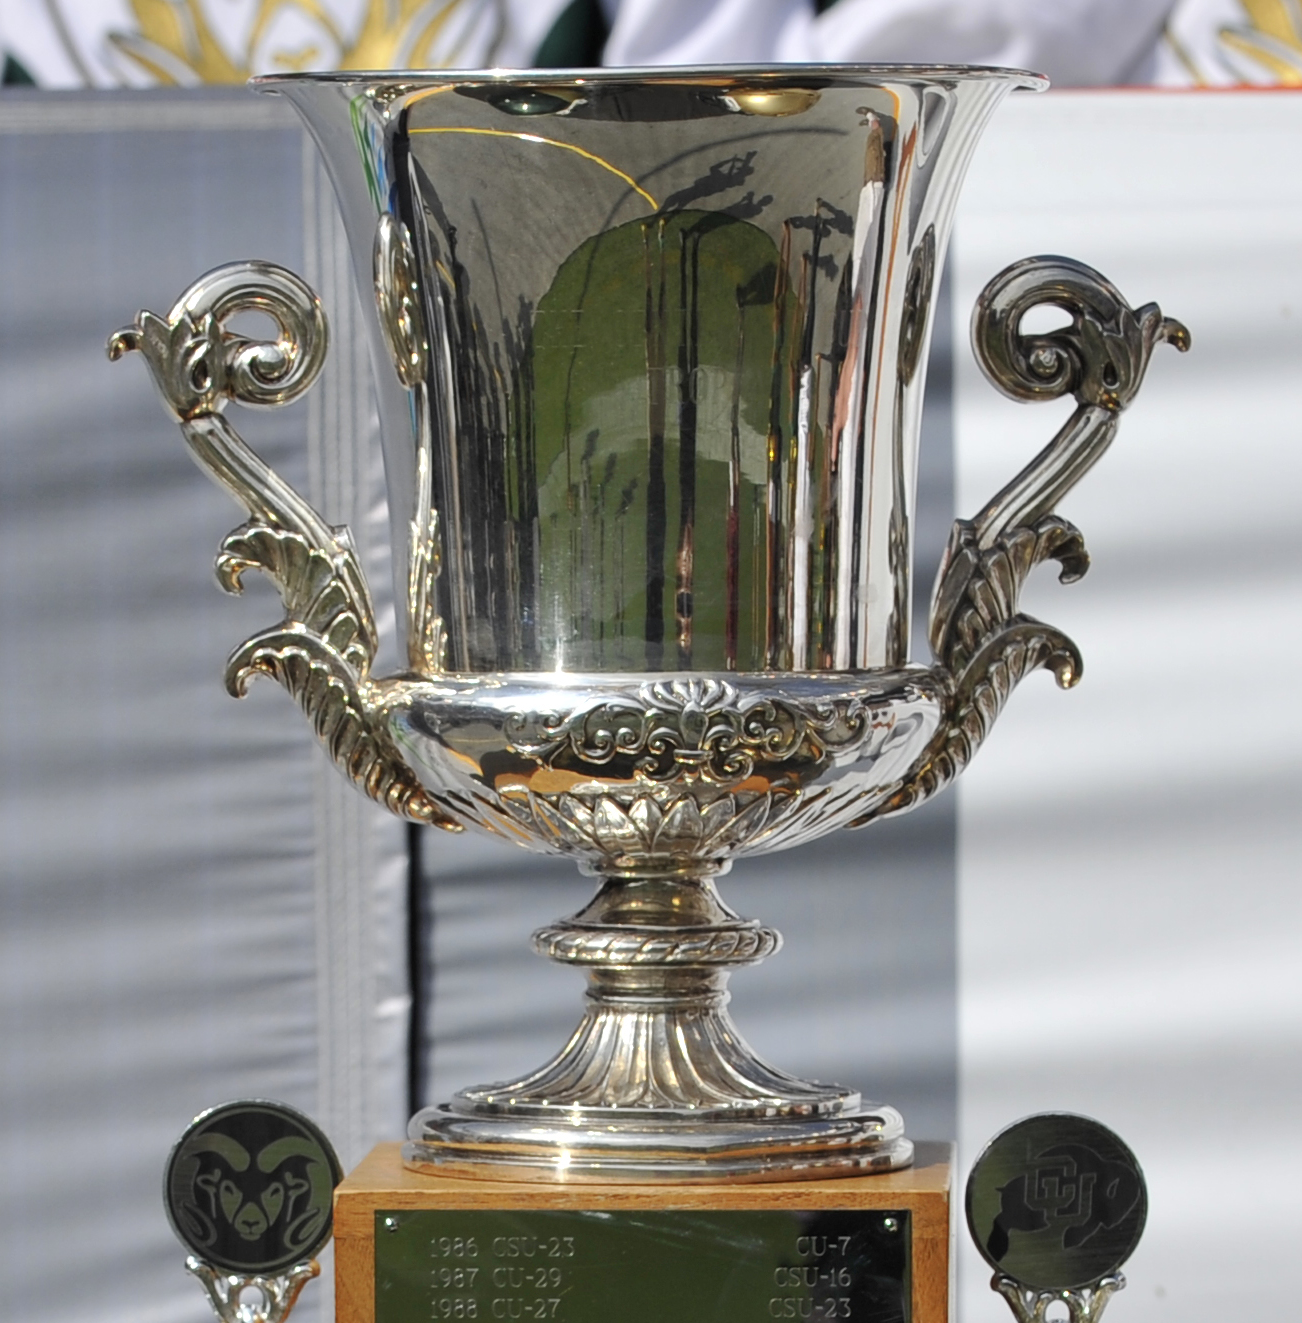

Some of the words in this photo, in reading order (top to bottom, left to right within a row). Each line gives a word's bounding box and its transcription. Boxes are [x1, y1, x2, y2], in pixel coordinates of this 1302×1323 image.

[430, 1236, 480, 1258] 1986
[492, 1236, 576, 1258] CSU-23
[795, 1235, 852, 1257] CU-7
[430, 1267, 480, 1289] 1987
[492, 1267, 563, 1289] CU-29
[773, 1266, 852, 1288] CSU-16
[430, 1298, 478, 1319] 1988
[491, 1298, 561, 1319] CU-27
[768, 1297, 852, 1319] CSU-23
